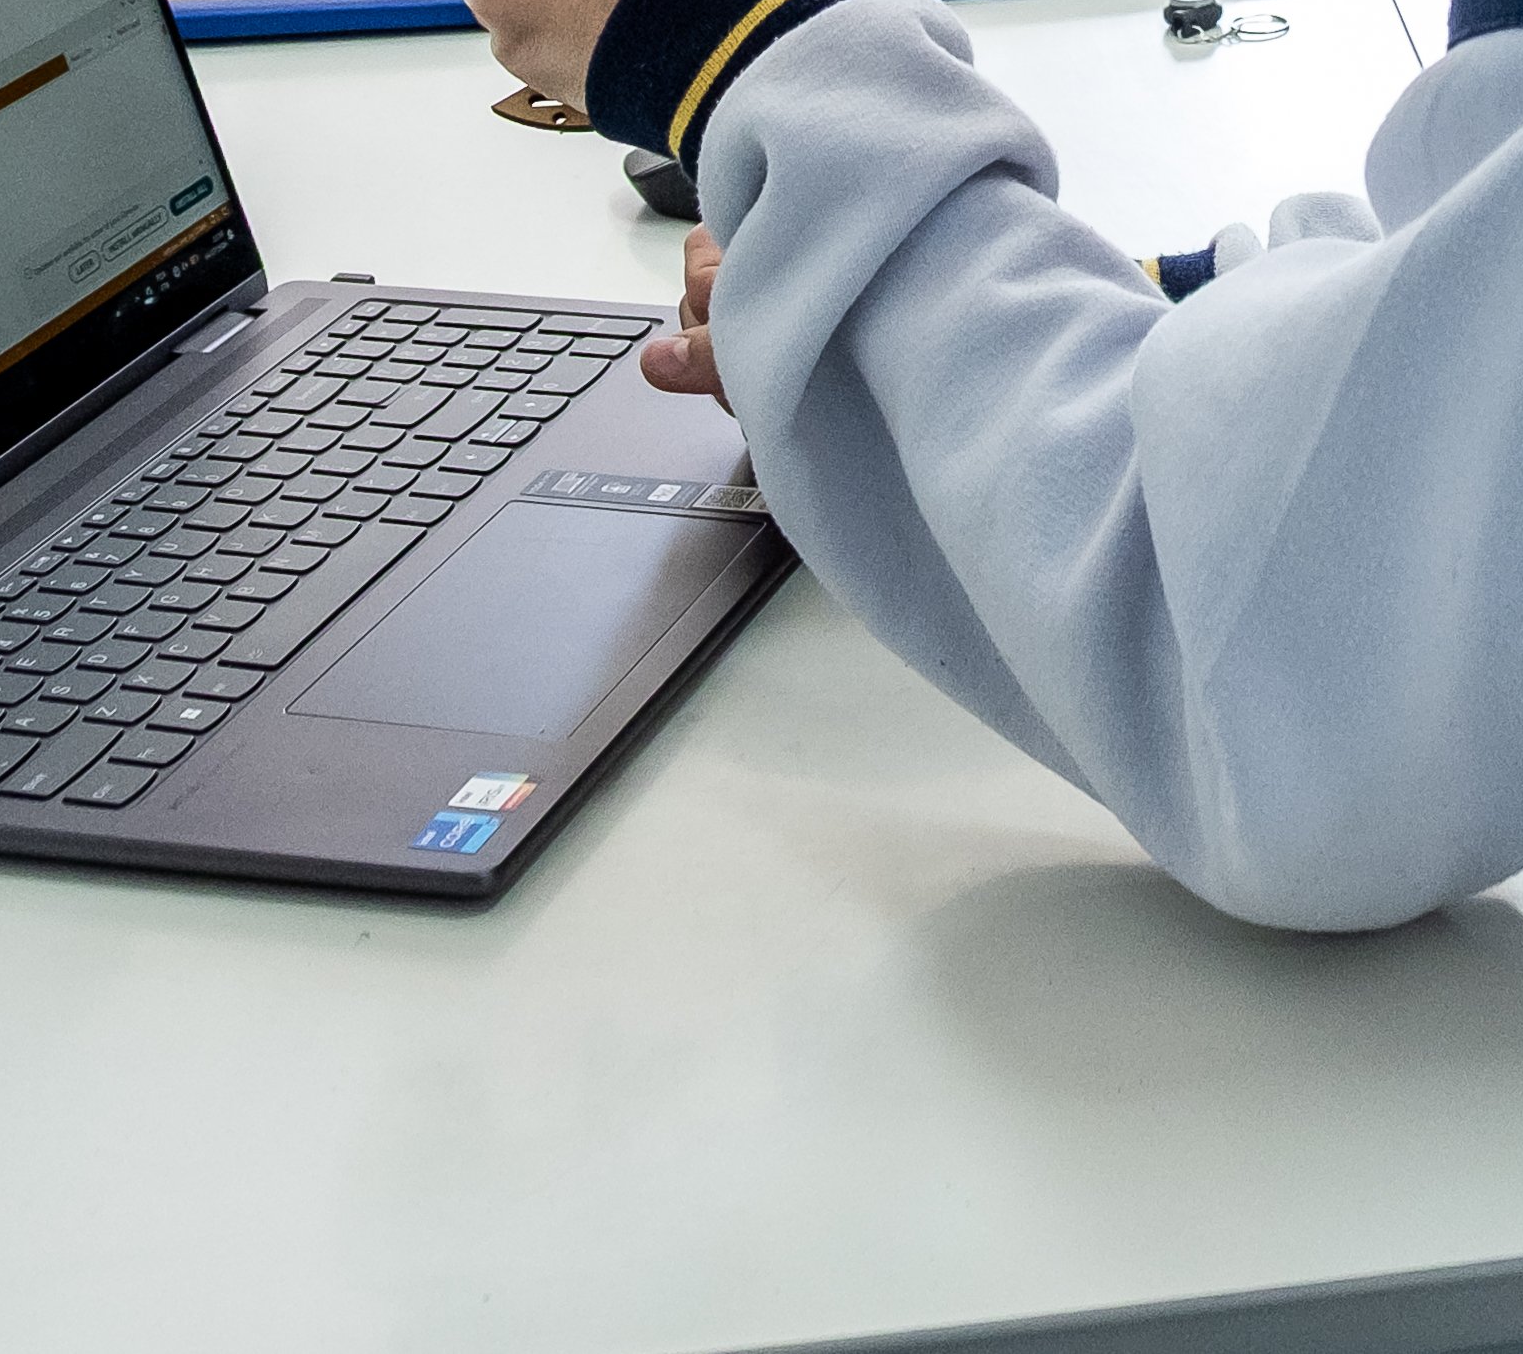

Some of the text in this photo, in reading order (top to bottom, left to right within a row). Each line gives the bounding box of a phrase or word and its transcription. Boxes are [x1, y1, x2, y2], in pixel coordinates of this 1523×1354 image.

[124, 569, 143, 580] Y
[89, 597, 108, 608] T
[160, 595, 179, 605] G
[53, 626, 74, 637] R
[124, 624, 141, 635] F
[16, 658, 36, 667] E
[87, 653, 107, 664] D
[51, 684, 71, 695] S
[95, 706, 117, 717] Z
[15, 716, 36, 727] A
